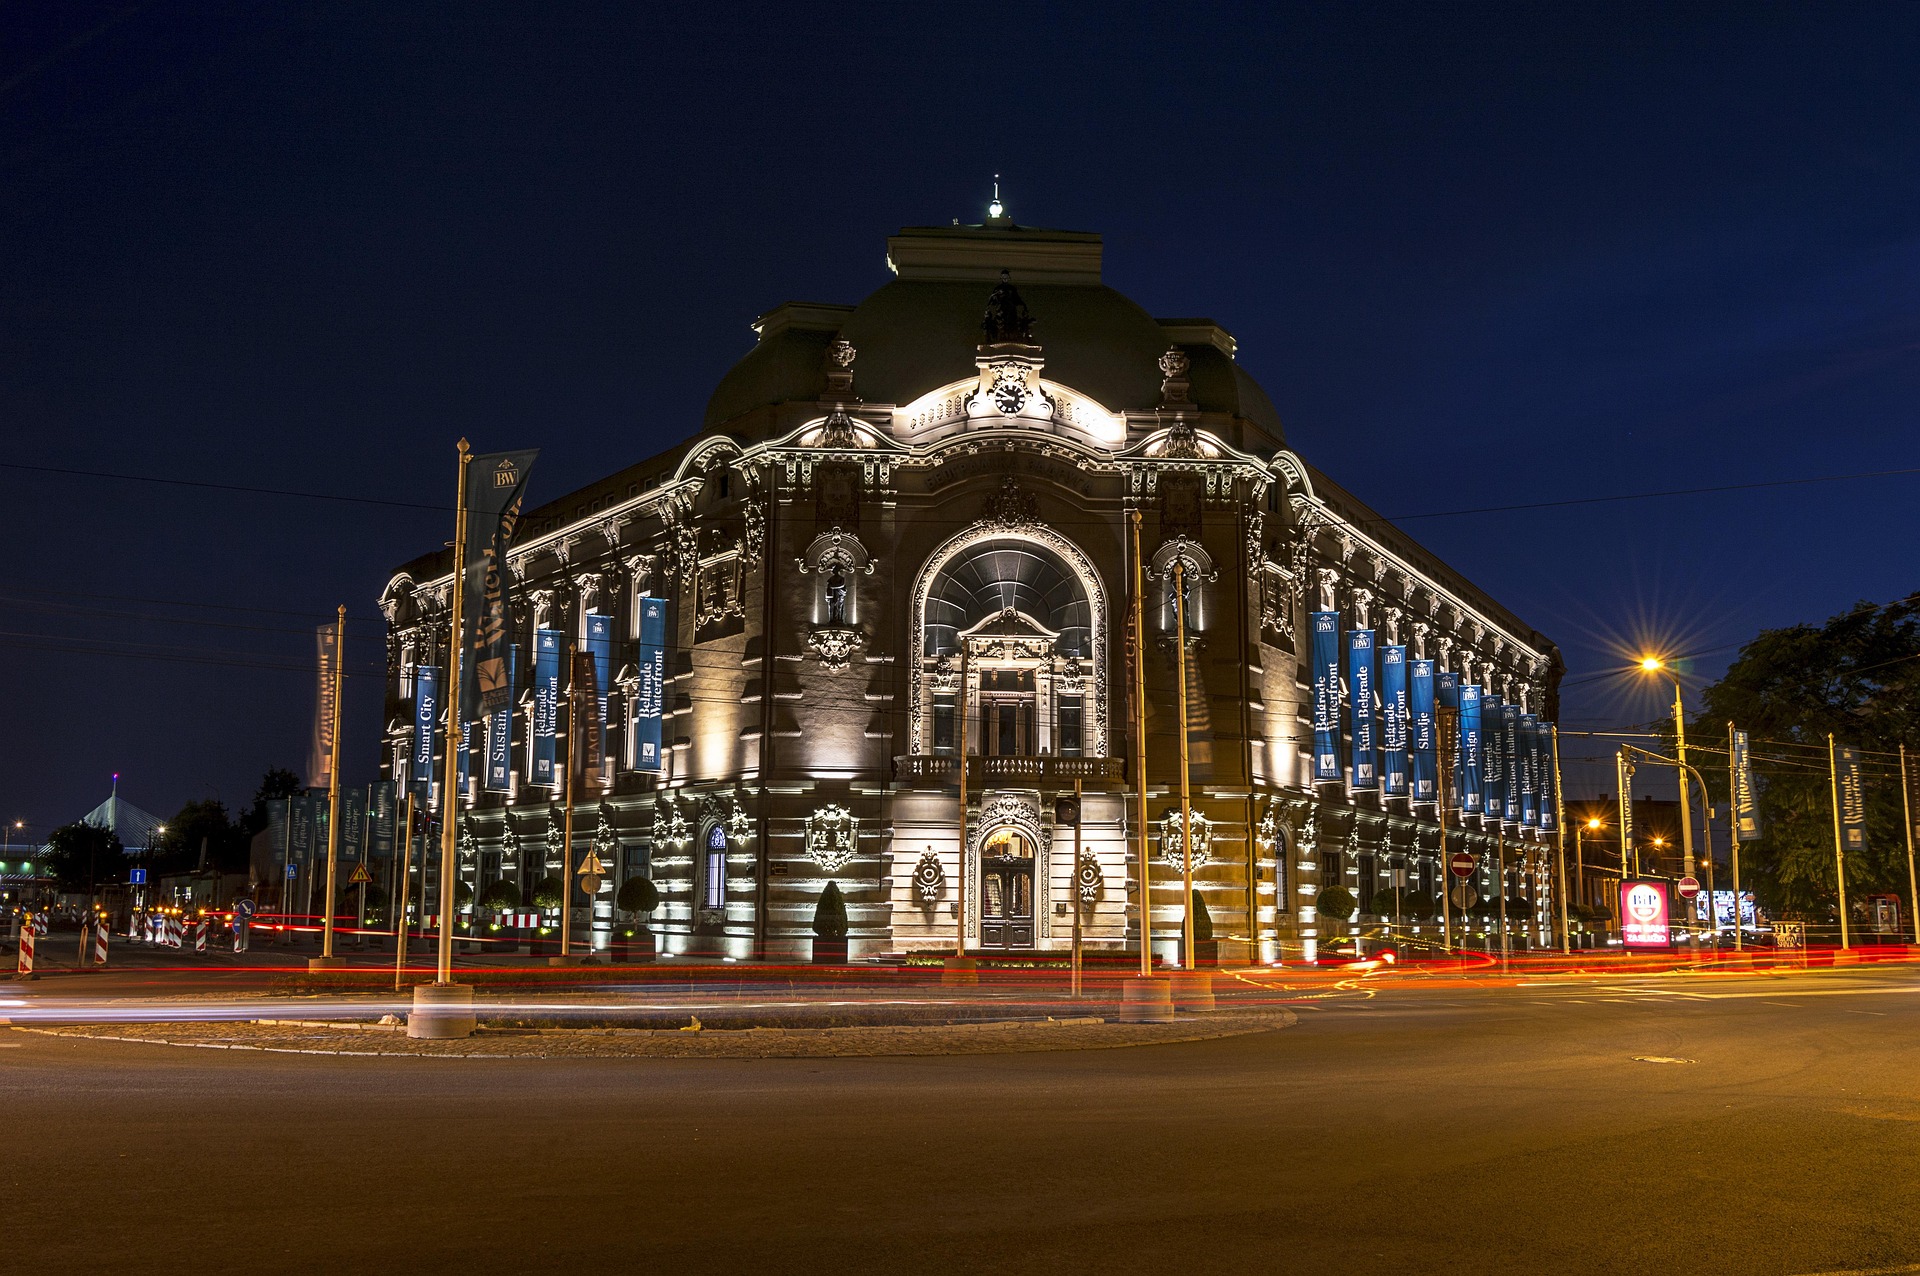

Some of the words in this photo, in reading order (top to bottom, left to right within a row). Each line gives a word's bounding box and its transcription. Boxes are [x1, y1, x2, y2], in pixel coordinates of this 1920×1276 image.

[496, 471, 516, 486] BW
[1319, 622, 1333, 631] BW
[1355, 640, 1369, 648] BW
[1387, 654, 1400, 663] BW
[1415, 668, 1428, 676] BW
[638, 662, 652, 719] Belgrade
[650, 650, 663, 719] Waterfront
[1315, 676, 1326, 732] Belgrade
[1326, 662, 1338, 732] Waterfront
[1357, 666, 1371, 718] Belgrade
[1464, 691, 1476, 699] BW
[420, 694, 435, 721] City
[535, 688, 547, 738] Belgrade
[545, 676, 558, 738] Waterfront
[1384, 703, 1396, 752] Belgrade
[1395, 690, 1406, 752] Waterfront
[418, 724, 431, 764] Smart
[1358, 723, 1371, 752] Kula
[1418, 712, 1430, 750] Slavlje
[1467, 731, 1478, 767] Design
[1506, 722, 1515, 755] kultura
[1483, 742, 1493, 783] Belgrade
[1493, 731, 1502, 782] Waterfront
[1521, 757, 1531, 795] Belgrade
[1530, 748, 1538, 794] Waterfront
[1541, 753, 1551, 801] Technology
[1508, 761, 1517, 804] Umetnost
